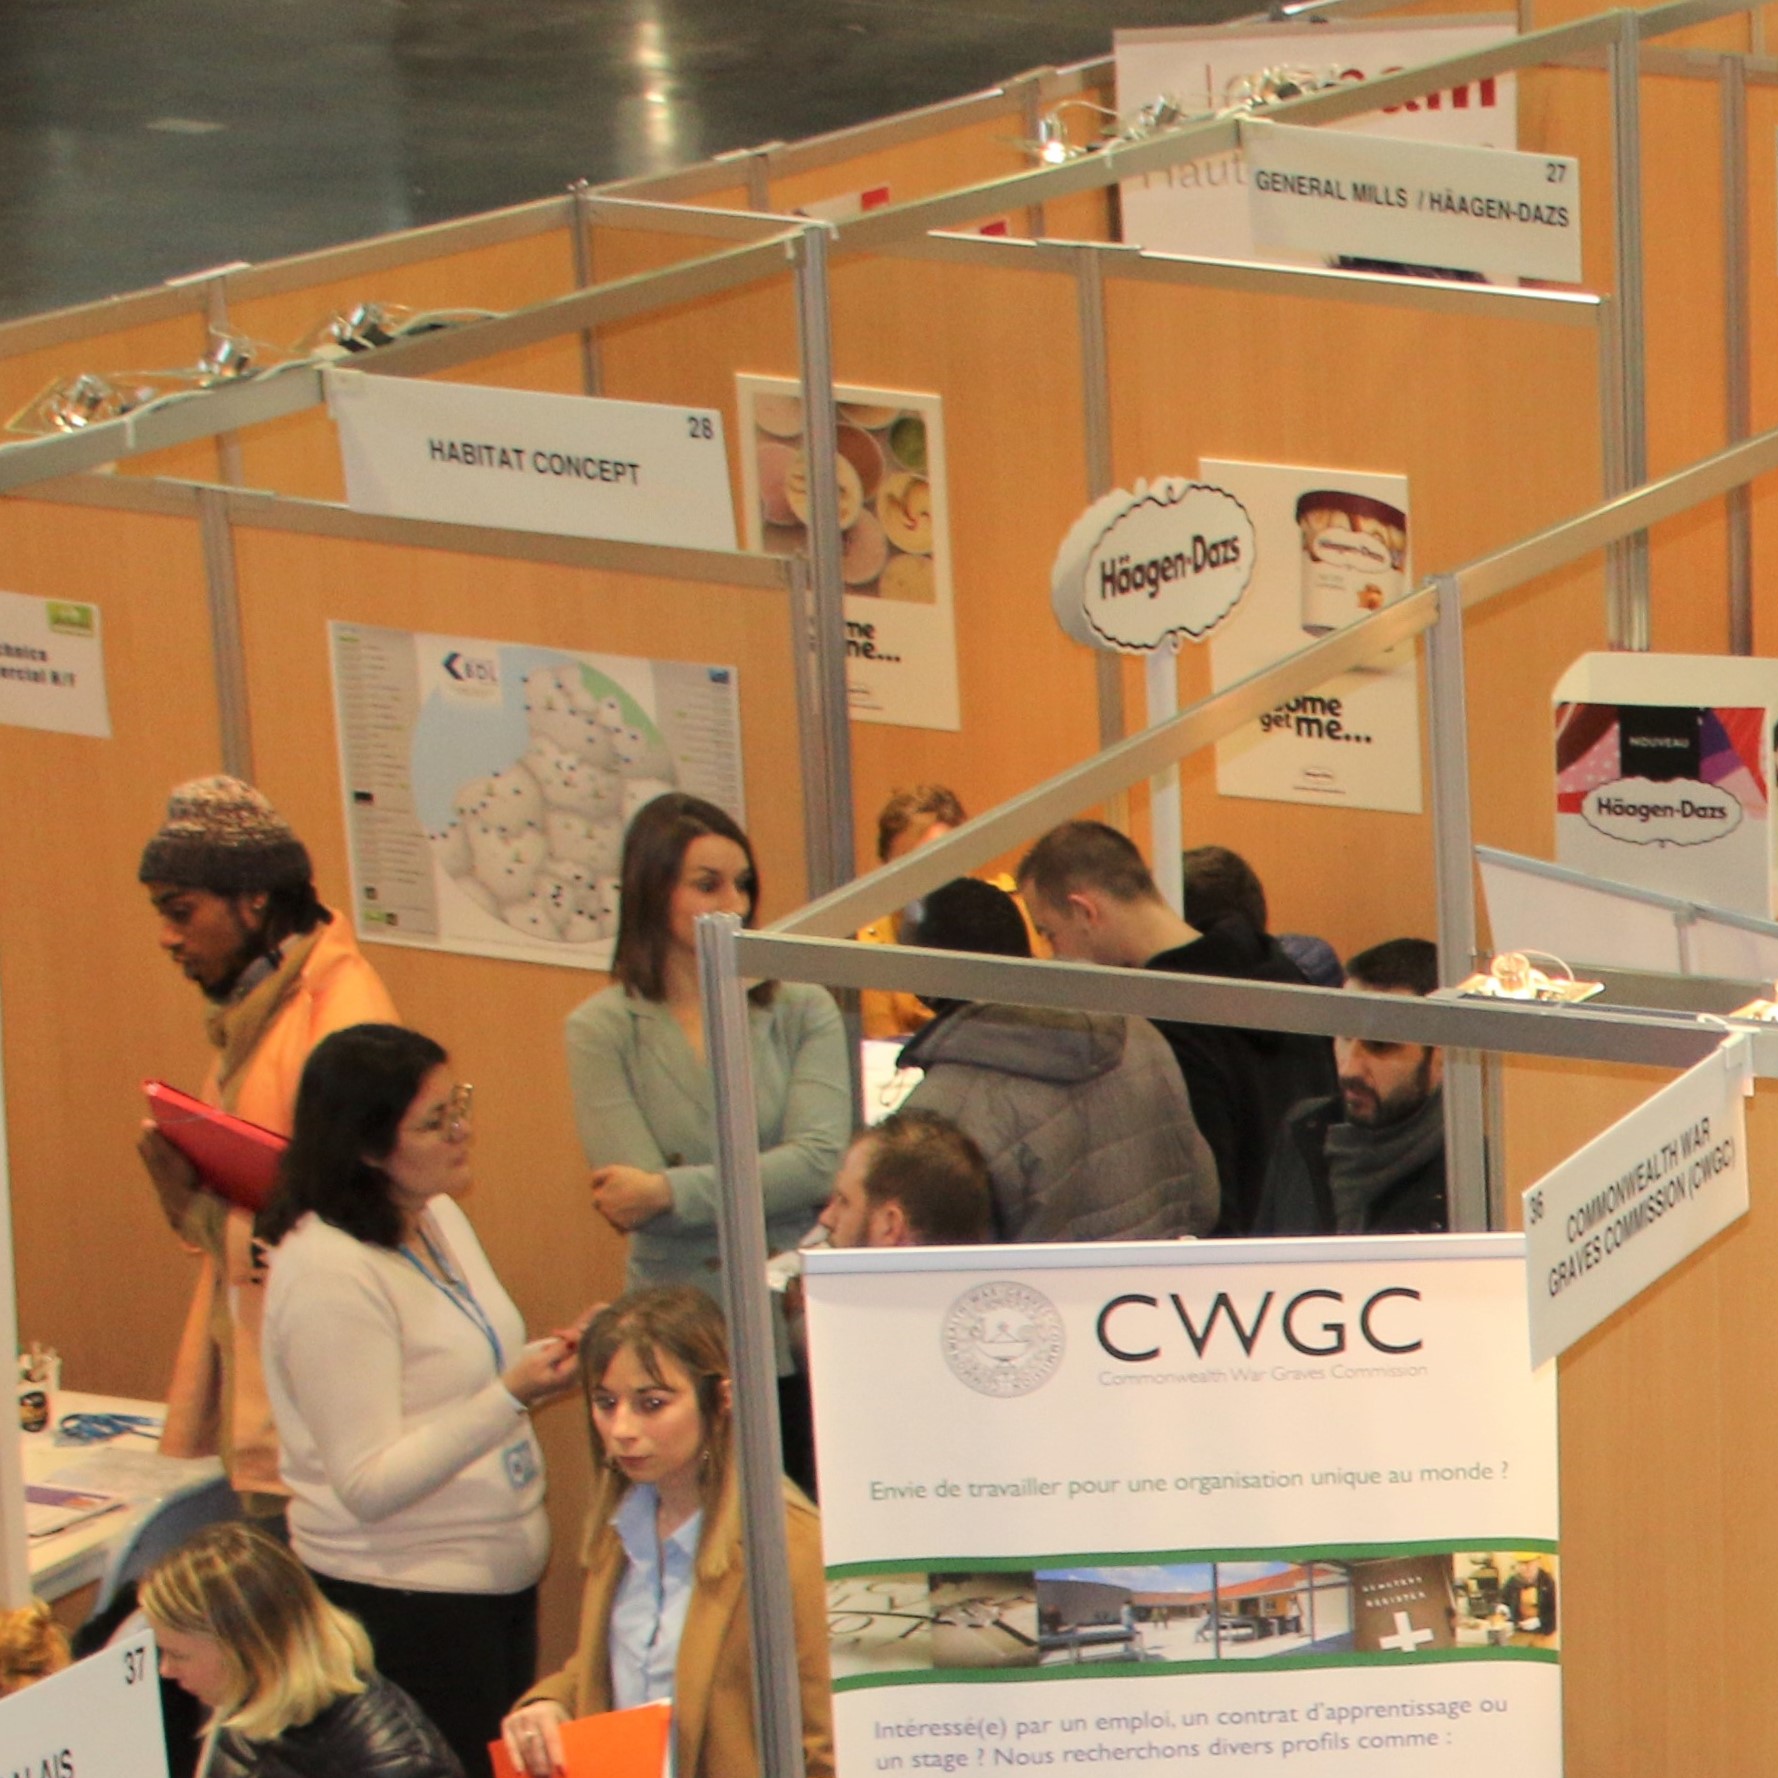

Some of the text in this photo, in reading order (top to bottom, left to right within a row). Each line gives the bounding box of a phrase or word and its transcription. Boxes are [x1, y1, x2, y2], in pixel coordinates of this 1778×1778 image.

[1546, 162, 1568, 183] 27
[1255, 169, 1348, 202] GENERAL
[1352, 182, 1408, 209] MILLS
[1430, 187, 1570, 228] HÄAGEN-DAZS
[428, 437, 641, 486] HABITAT CONCEPT
[1100, 535, 1241, 600] Häagen-Dazs
[1597, 796, 1728, 823] Häagen-Dazs
[1565, 1116, 1711, 1243] COMMONWEALTH WAR
[1547, 1135, 1736, 1298] GRAVES COMMISSION (CWGC)
[1096, 1286, 1424, 1363] CWGC
[1099, 1362, 1428, 1387] Commonwealth War Graves Commission
[870, 1461, 1510, 1500] Envie de travailler pour une organisation unique au monde ?
[123, 1646, 145, 1685] 37
[875, 1716, 1008, 1741] Intéressé(e)
[1015, 1719, 1052, 1741] par
[1060, 1717, 1088, 1733] un
[1182, 1711, 1209, 1727] un
[1217, 1707, 1299, 1726] contrat
[1306, 1698, 1473, 1726] d'apprentissage
[1480, 1697, 1508, 1714] ou
[876, 1731, 1440, 1773] un stage ? Nous recherchons divers profils comme
